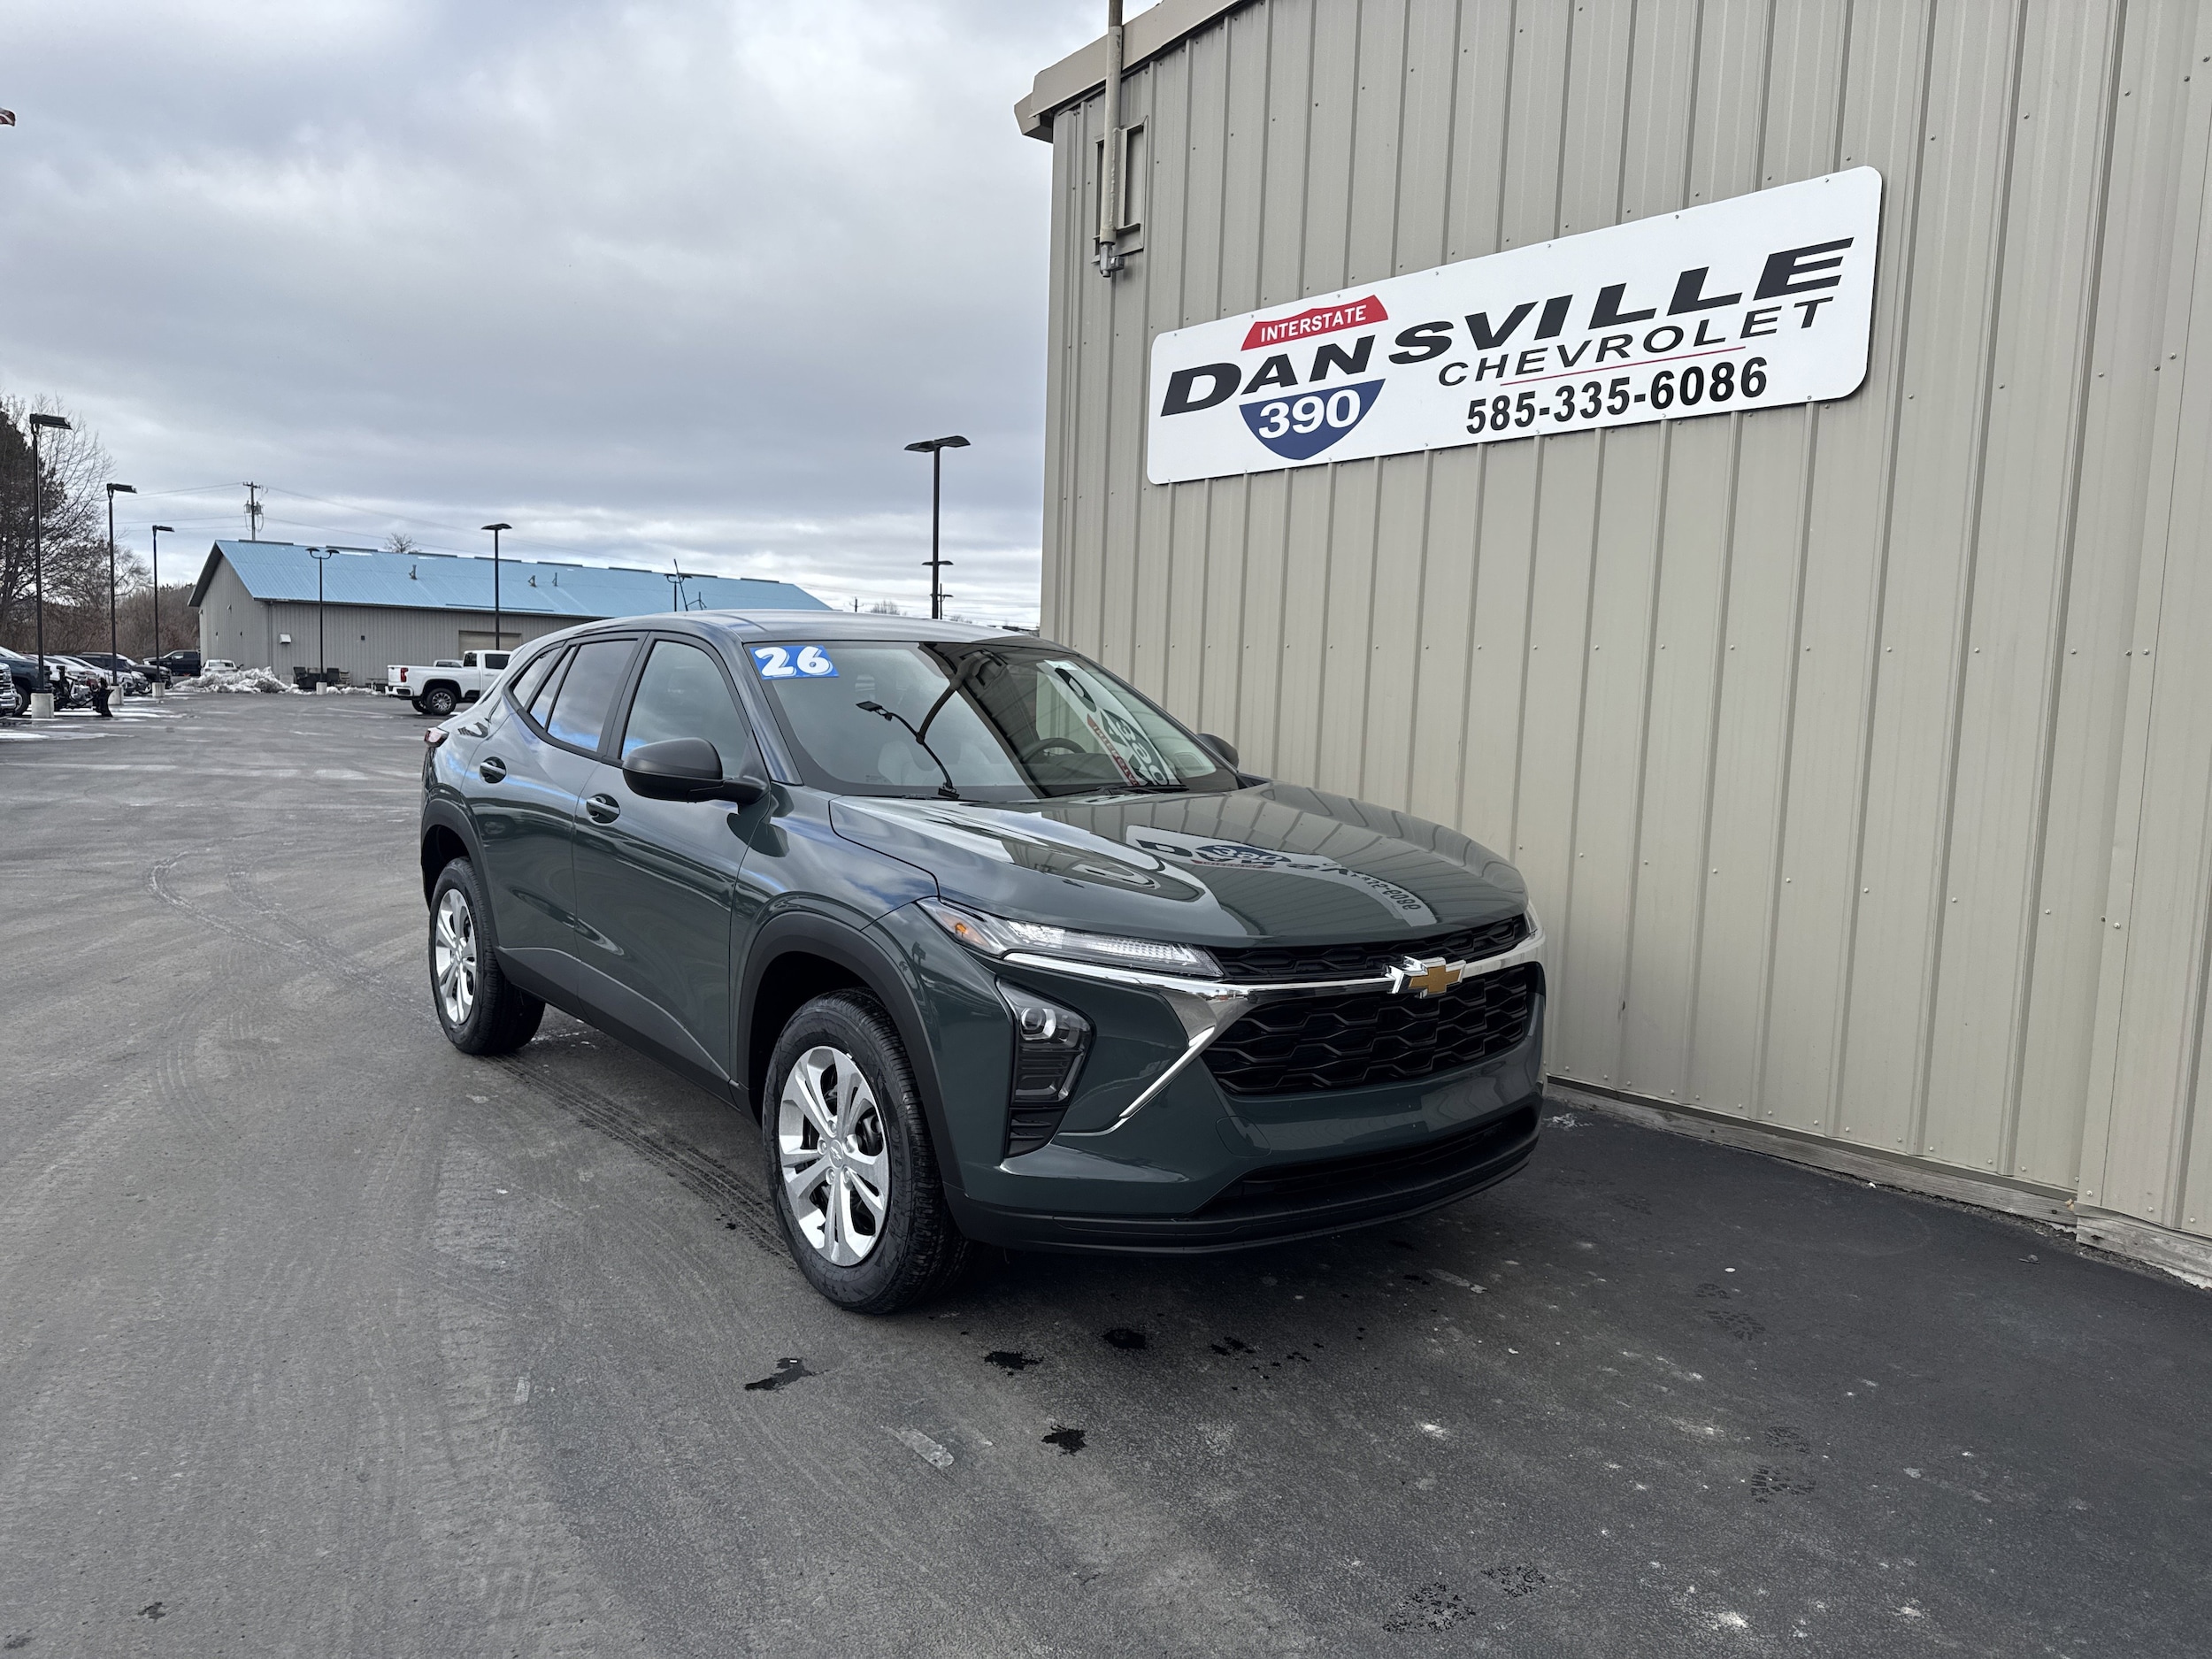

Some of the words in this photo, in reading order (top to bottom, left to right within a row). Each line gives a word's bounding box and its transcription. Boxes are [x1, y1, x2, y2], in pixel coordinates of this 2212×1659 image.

[1161, 237, 1855, 417] DANSVILLE
[1260, 304, 1367, 343] INTERSTATE
[1439, 296, 1834, 387] CHEVROLET
[1258, 388, 1361, 439] 390
[1466, 357, 1768, 434] 585-335-6086
[754, 646, 833, 678] 26
